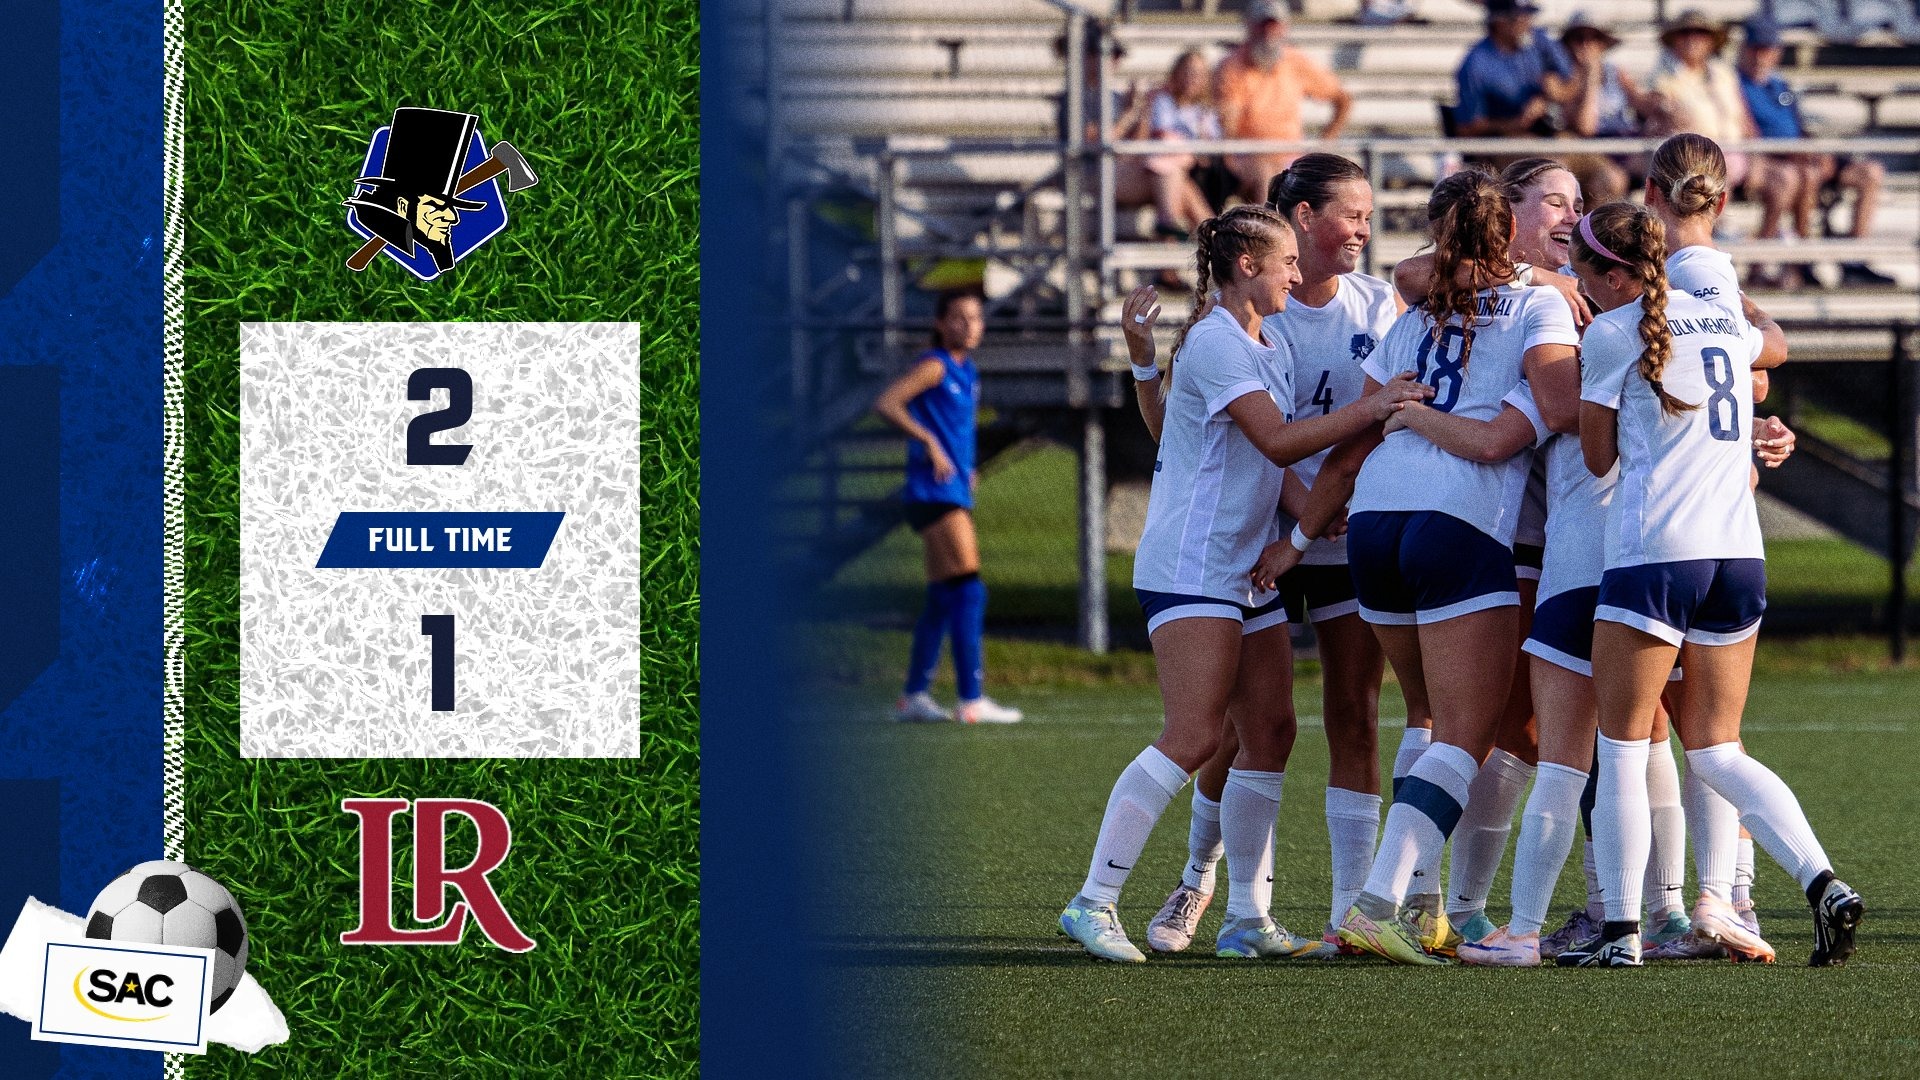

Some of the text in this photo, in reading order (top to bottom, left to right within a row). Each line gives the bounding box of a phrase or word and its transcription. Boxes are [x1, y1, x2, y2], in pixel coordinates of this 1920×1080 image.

[1693, 286, 1720, 300] SAC
[1311, 370, 1334, 415] 4
[1416, 325, 1476, 413] 18
[1700, 346, 1740, 442] 8
